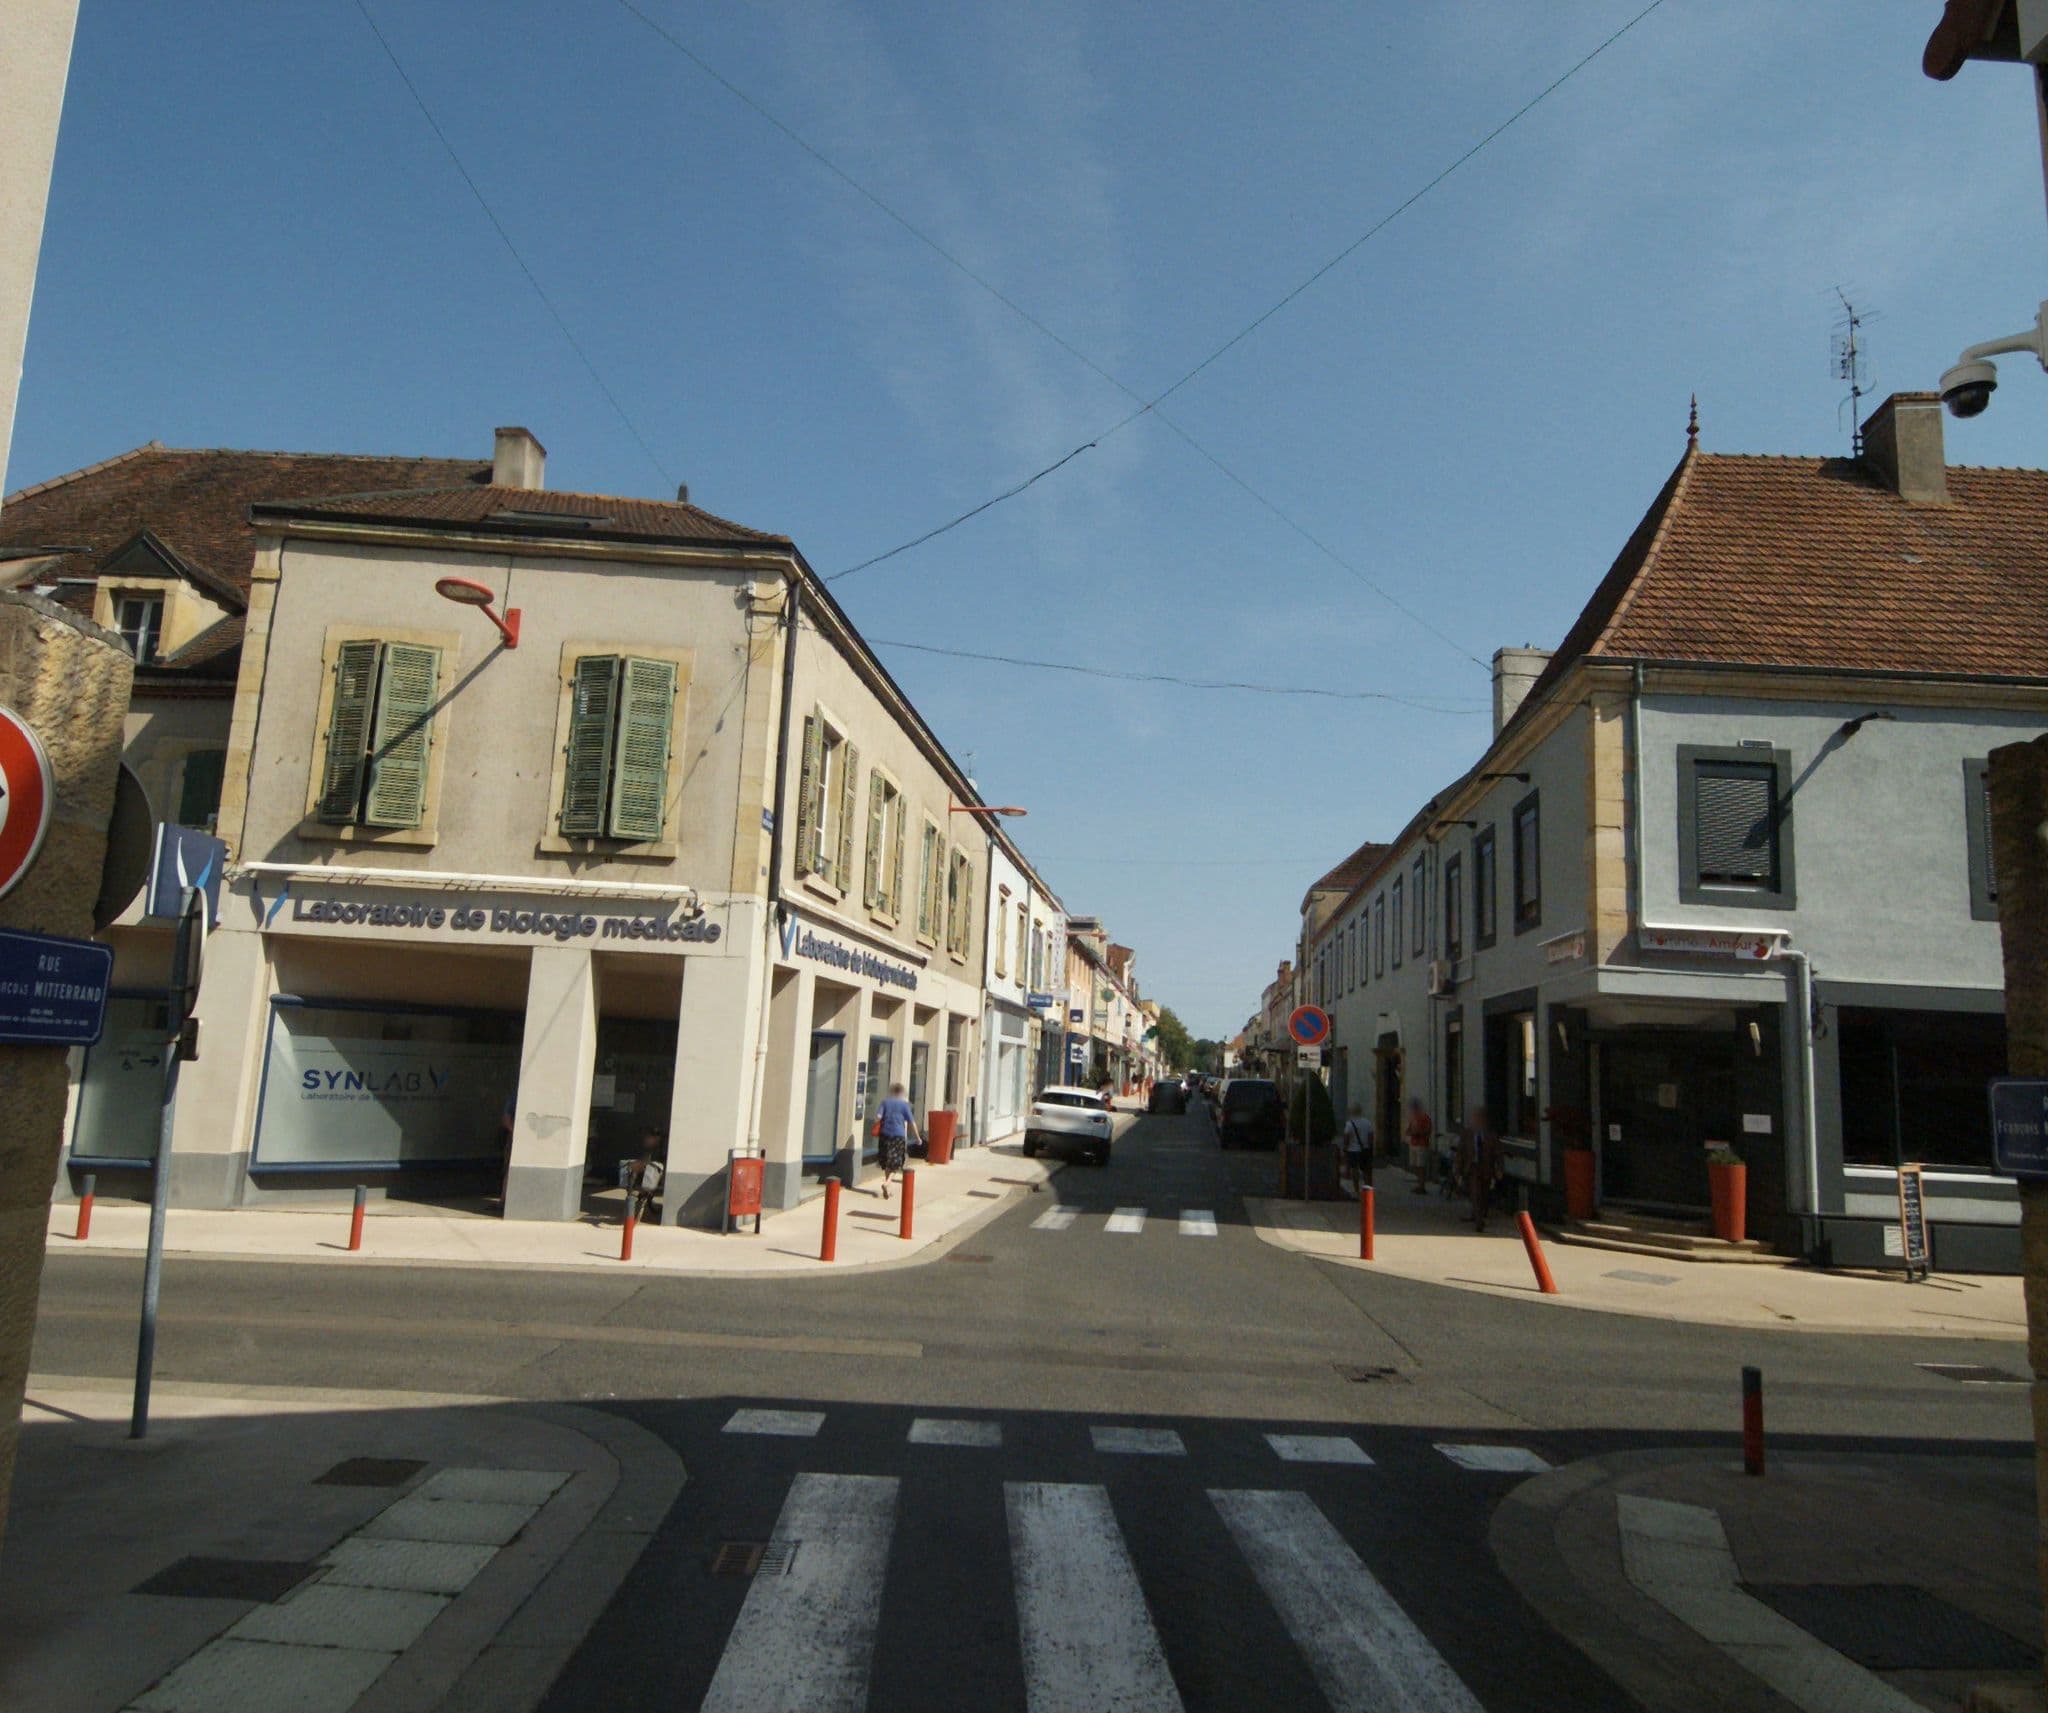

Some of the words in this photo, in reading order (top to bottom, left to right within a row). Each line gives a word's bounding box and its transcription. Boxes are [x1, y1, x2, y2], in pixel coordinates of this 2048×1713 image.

[293, 897, 446, 930] Laboratoire
[451, 904, 487, 932] de
[490, 906, 597, 941] biologie
[602, 914, 722, 943] médicale
[795, 925, 850, 970] Laboratoire
[850, 948, 861, 974] de
[38, 954, 61, 972] RUE
[34, 981, 102, 1002] MITTERRAND
[302, 1069, 421, 1092] SYNLAB
